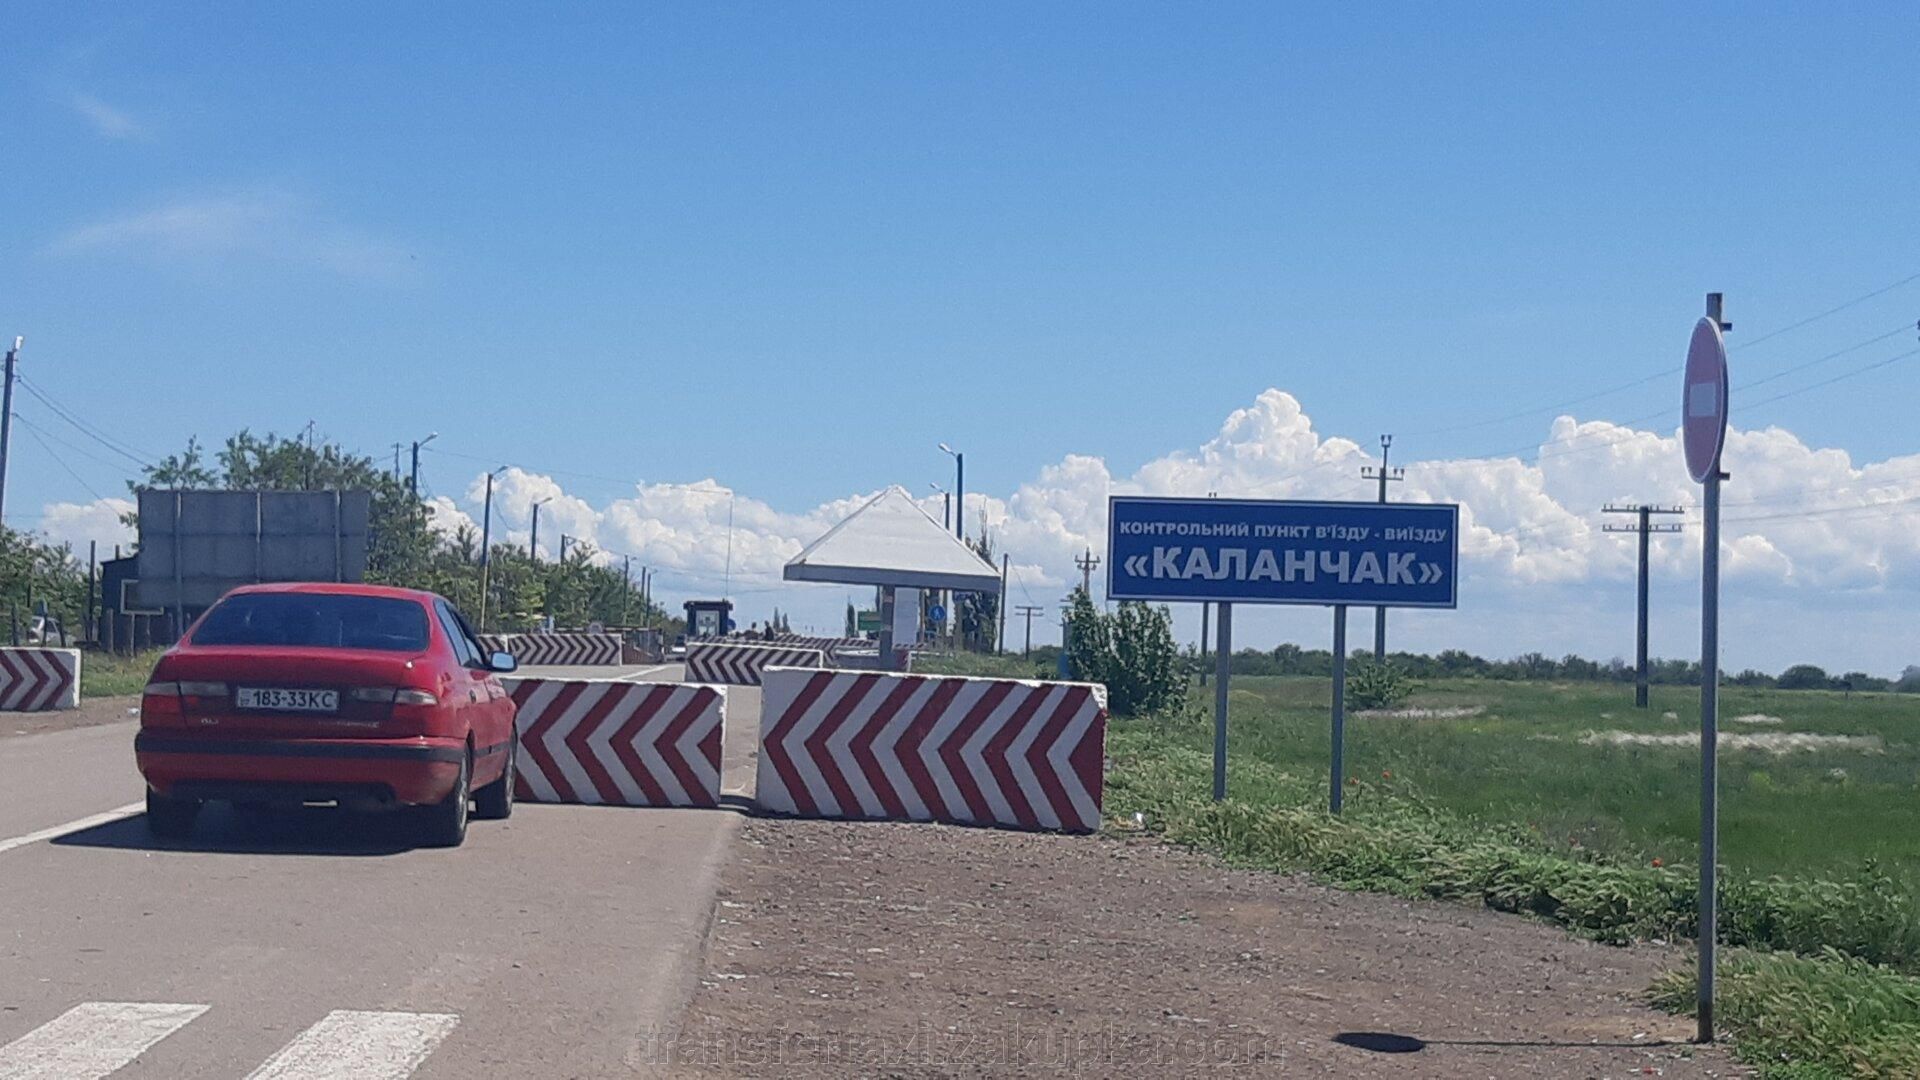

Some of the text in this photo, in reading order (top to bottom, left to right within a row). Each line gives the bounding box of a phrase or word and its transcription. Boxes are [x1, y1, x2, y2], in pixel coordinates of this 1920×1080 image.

[1119, 521, 1249, 538] КОНТРОЛЬНИЙ
[1254, 524, 1311, 538] ПУНКТ
[1384, 525, 1447, 543] ВИЇЗДУ
[1123, 546, 1444, 585] «КАЛАНЧАК»
